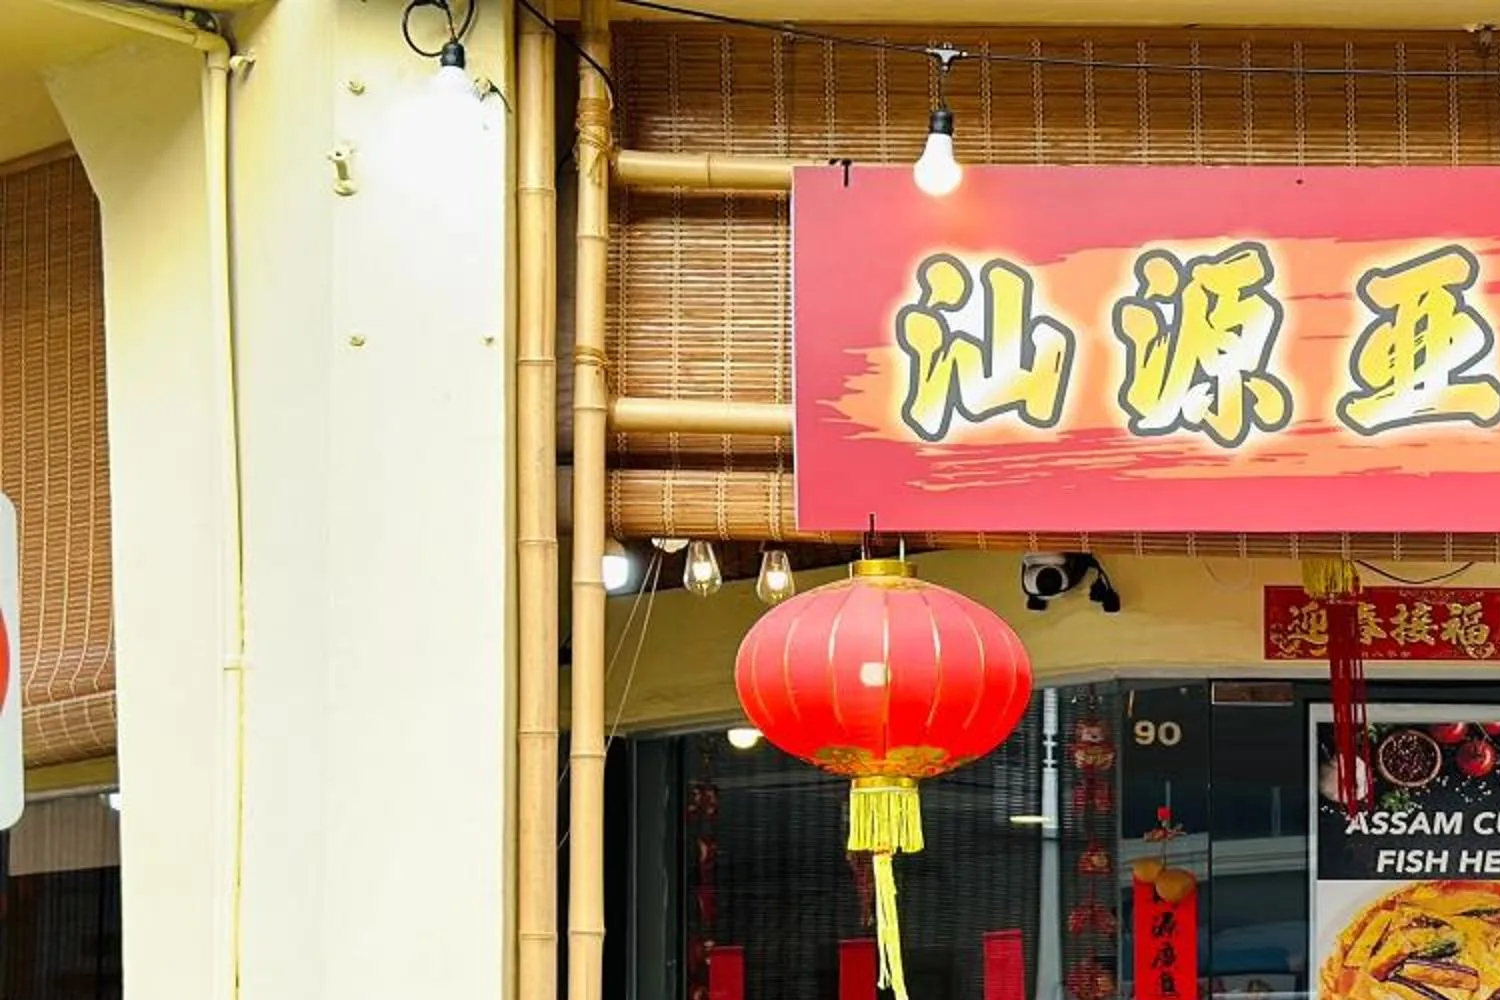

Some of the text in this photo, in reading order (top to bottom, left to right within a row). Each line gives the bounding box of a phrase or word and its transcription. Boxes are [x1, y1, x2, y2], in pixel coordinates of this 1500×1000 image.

[1134, 720, 1182, 746] 90
[1345, 811, 1463, 835] ASSAM
[1376, 850, 1449, 874] FISH
